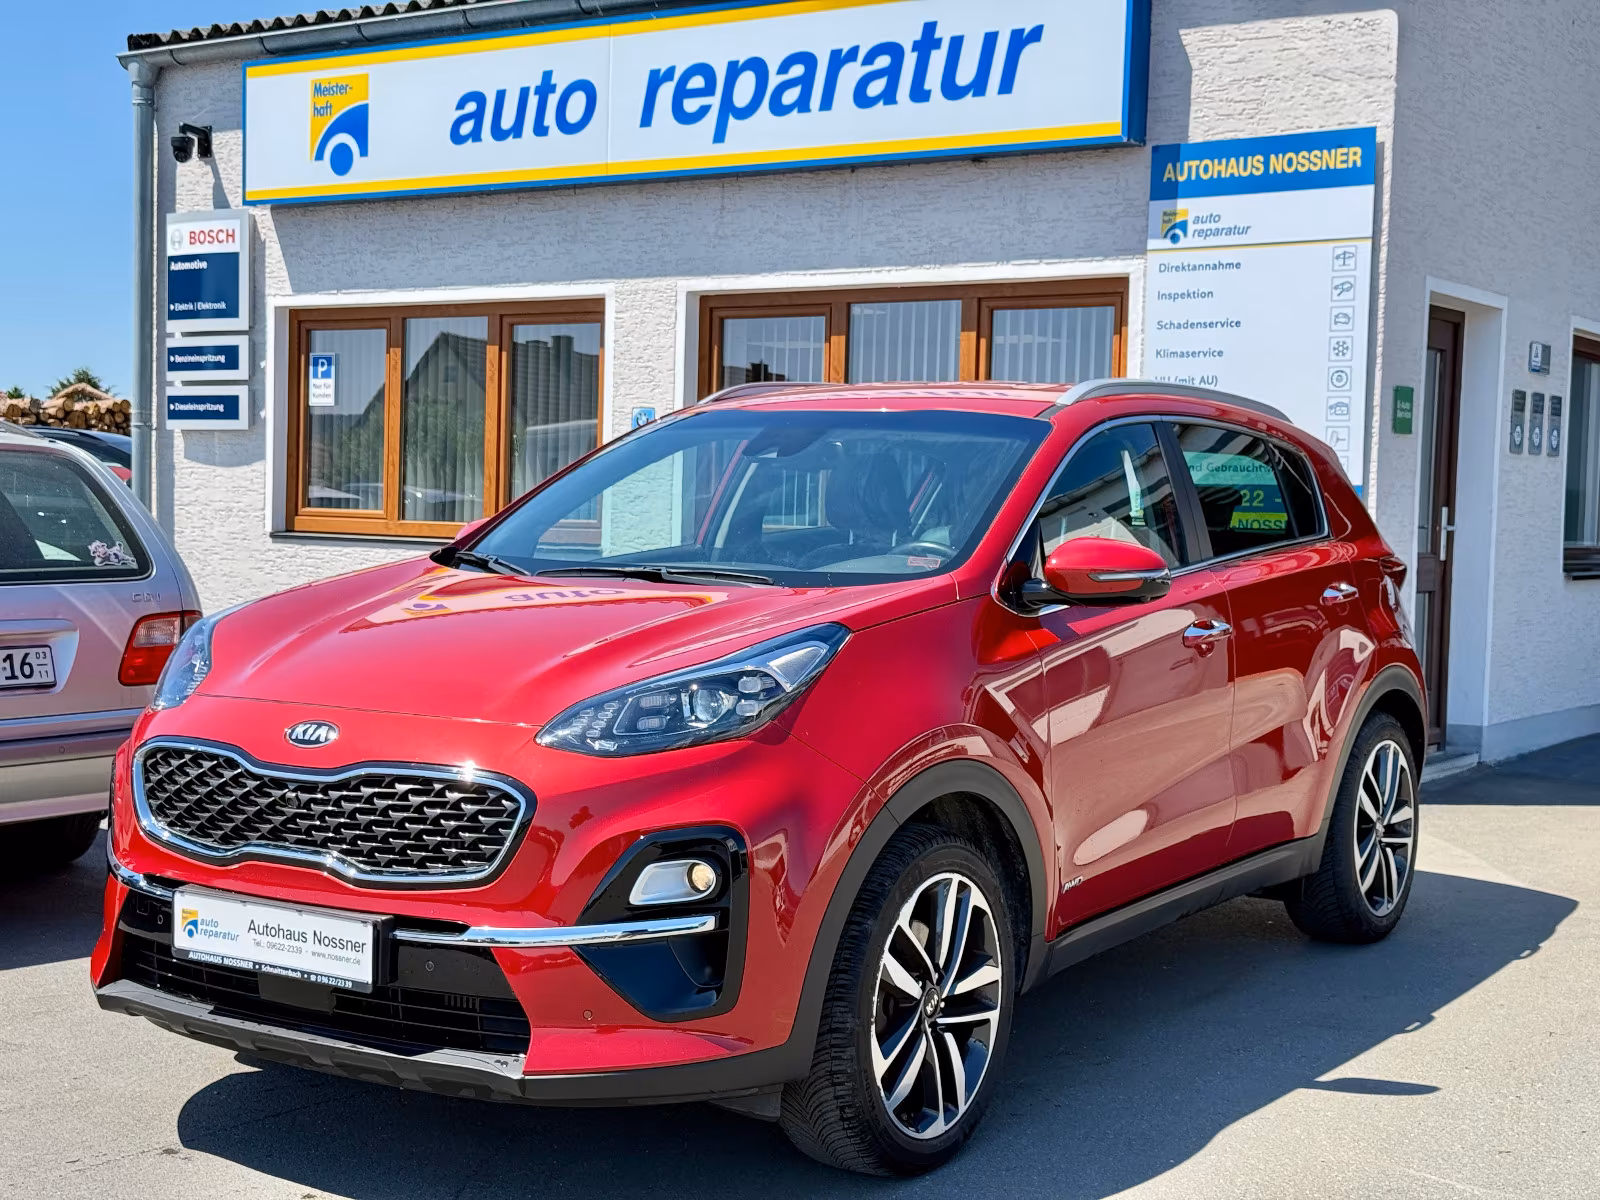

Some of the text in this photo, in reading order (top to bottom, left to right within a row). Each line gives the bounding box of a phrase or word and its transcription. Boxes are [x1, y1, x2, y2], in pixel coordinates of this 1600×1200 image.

[313, 81, 353, 99] Meister-
[449, 20, 1044, 146] auto reparatur
[313, 99, 333, 118] haft
[1162, 145, 1363, 183] AUTOHAUS NOSSNER
[1192, 211, 1222, 225] auto
[188, 228, 236, 246] BOSCH
[1191, 224, 1252, 240] reparatur
[169, 259, 208, 272] Automotive
[1158, 260, 1242, 274] Direktannahme
[1156, 288, 1214, 303] Inspektion
[174, 300, 227, 312] Elektrik Elektronik
[1156, 317, 1242, 331] Schadenservice
[1155, 347, 1225, 360] Klimaservice
[317, 358, 329, 379] P
[1198, 373, 1219, 388] AU)
[174, 402, 225, 413] Dieseleinspritzung
[35, 651, 47, 660] 03
[291, 723, 329, 743] KIA
[199, 918, 219, 929] auto
[199, 927, 240, 942] reparatur
[247, 919, 367, 954] Autohaus Nossner
[188, 950, 254, 971] AUTOHAUS NOSSNER
[266, 940, 303, 956] 09622-2339
[311, 949, 361, 967] www.nossner.de
[925, 993, 939, 1015] KIA
